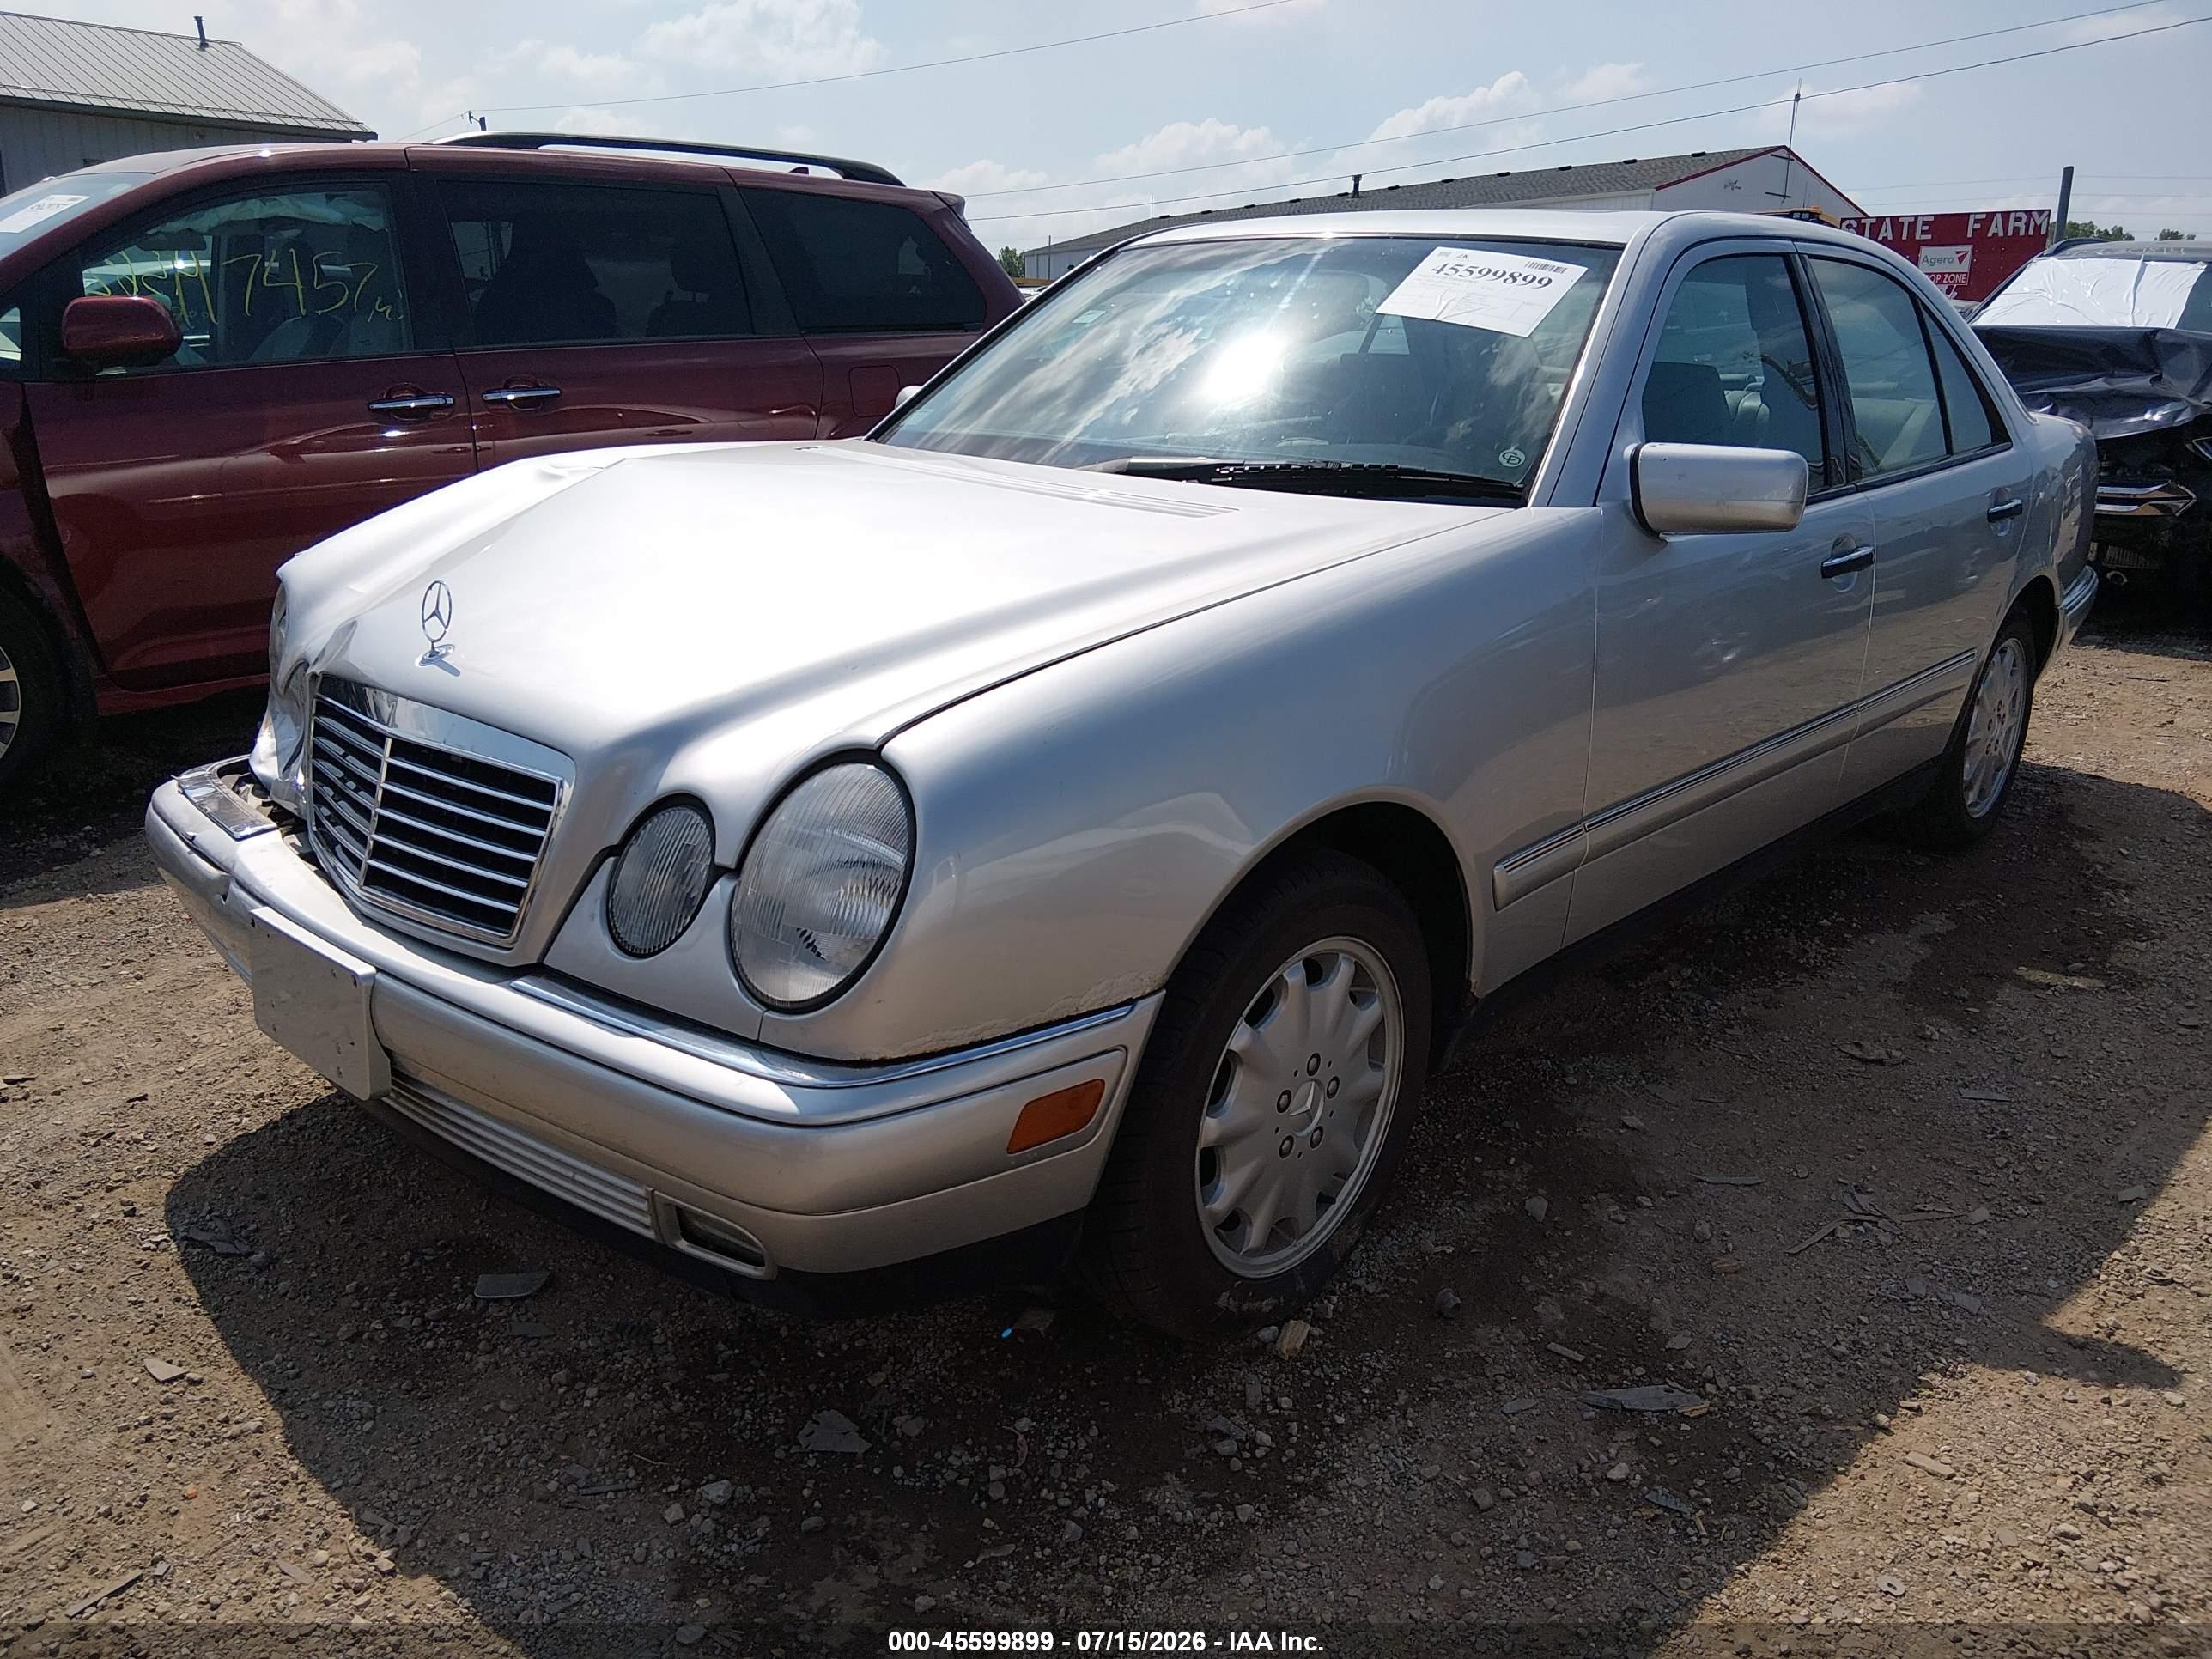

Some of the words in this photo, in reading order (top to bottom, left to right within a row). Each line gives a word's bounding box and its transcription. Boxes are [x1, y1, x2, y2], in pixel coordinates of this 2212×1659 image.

[1841, 216, 1935, 241] STATE
[1966, 211, 2051, 238] FARM
[1922, 254, 1954, 267] Agero
[1431, 262, 1553, 289] 45599899
[1942, 273, 1967, 283] ZONE
